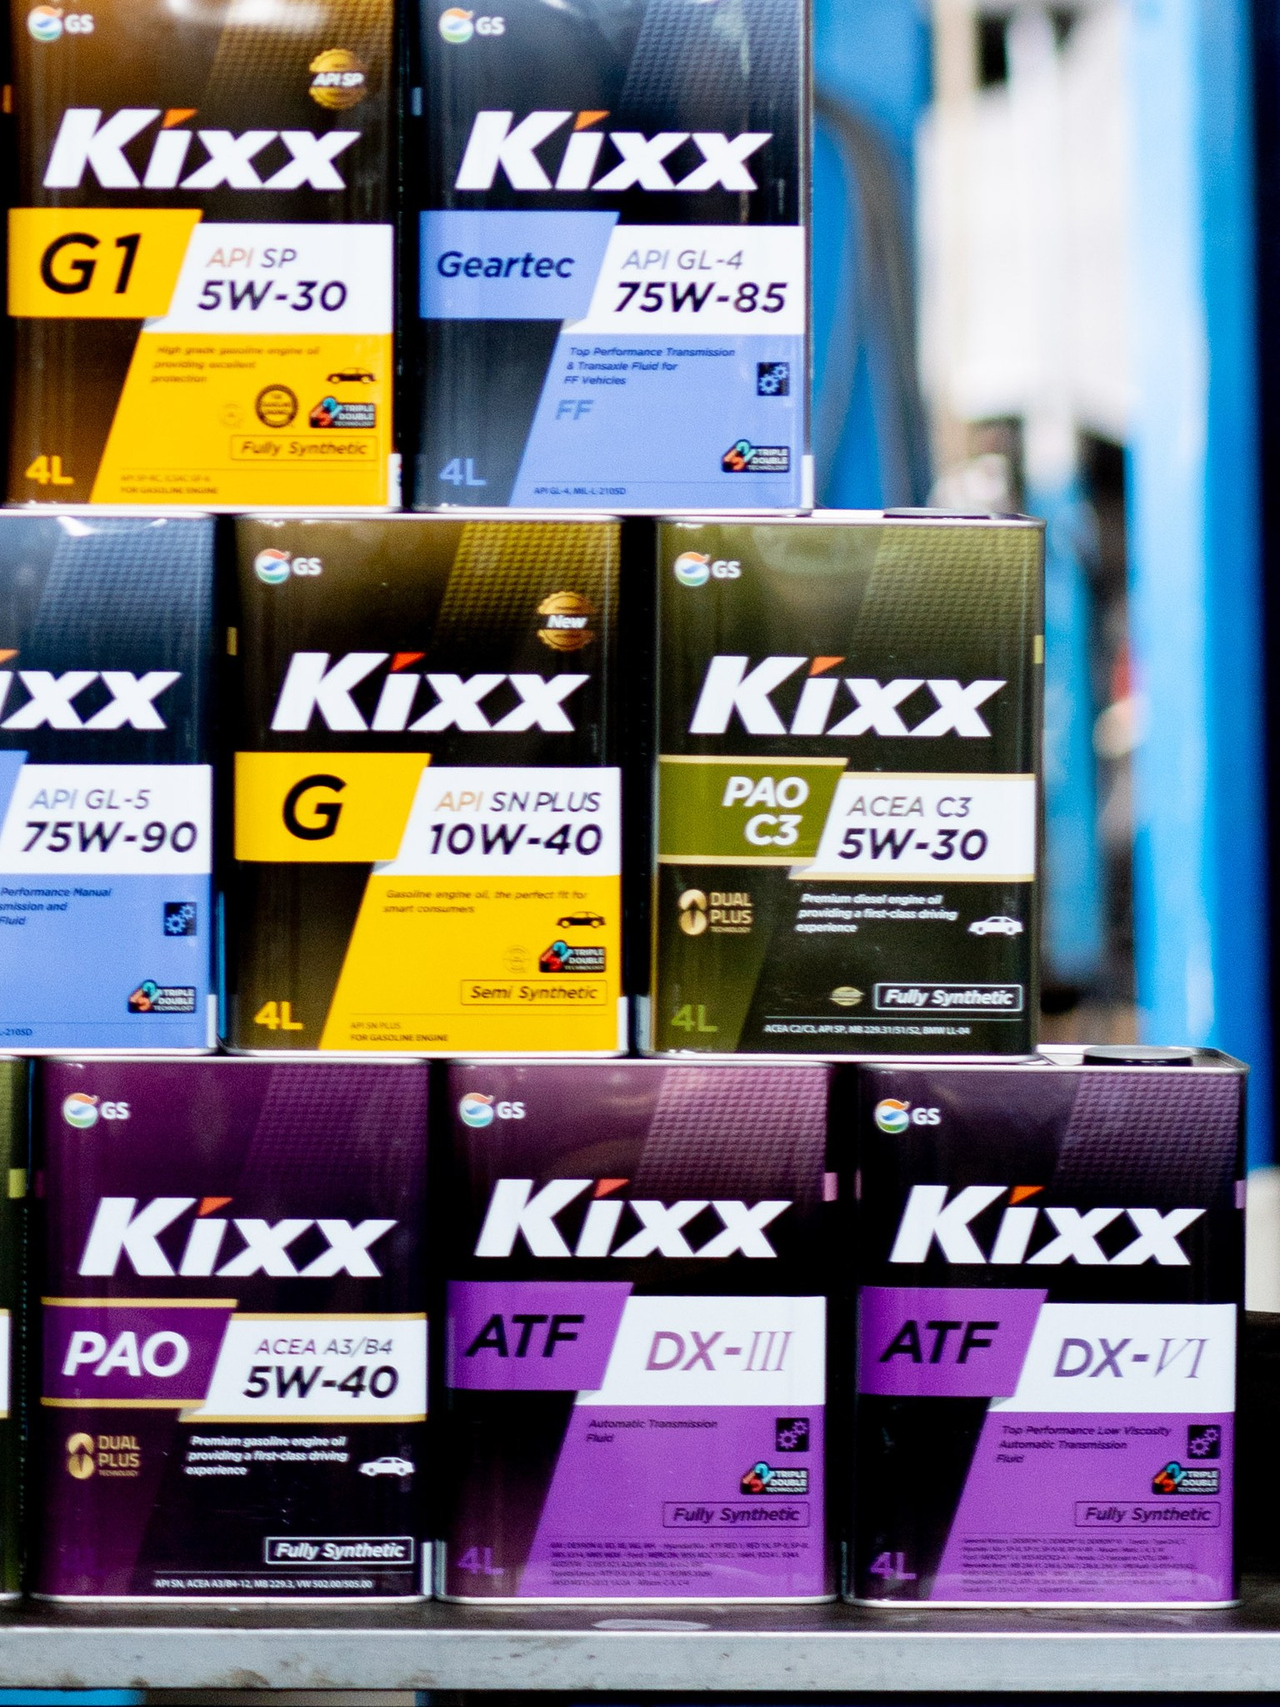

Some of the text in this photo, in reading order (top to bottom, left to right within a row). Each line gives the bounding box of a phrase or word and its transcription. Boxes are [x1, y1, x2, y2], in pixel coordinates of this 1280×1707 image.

[64, 14, 94, 34] GS
[475, 17, 505, 35] GS
[313, 73, 364, 86] API SP
[42, 108, 361, 190] Kixx
[454, 110, 773, 191] Kixx
[41, 233, 141, 295] G1
[206, 249, 297, 268] API SP
[437, 251, 575, 278] Geartec
[621, 249, 744, 270] API GL-4
[198, 281, 347, 312] 5W-30
[614, 282, 788, 313] 75W-85
[555, 400, 594, 420] FF
[242, 441, 368, 456] Fully Synthetic
[25, 455, 74, 485] 4L
[439, 458, 487, 486] 4L
[292, 557, 322, 575] GS
[712, 560, 741, 578] GS
[548, 615, 587, 627] New
[270, 652, 591, 732] Kixx
[689, 656, 1007, 737] Kixx
[29, 789, 151, 810] API GL-5
[434, 791, 601, 812] API SN PLUS
[722, 777, 809, 808] PAO
[282, 774, 347, 841] G
[847, 797, 973, 817] ACEA C3
[21, 821, 198, 853] 75W-90
[430, 823, 603, 855] 10W-40
[745, 814, 803, 846] C3
[838, 828, 988, 861] 5W-30
[0, 887, 71, 897] Performance
[73, 887, 111, 897] Manual
[710, 892, 752, 907] DUAL
[46, 902, 68, 910] and
[710, 910, 752, 924] PLUS
[158, 997, 195, 1005] DOUBLE
[471, 986, 599, 1000] Semi Synthetic
[885, 989, 928, 1006] Fully
[932, 989, 1014, 1006] Synthetic
[254, 1001, 303, 1031] 4L
[671, 1005, 718, 1032] 4L
[101, 1102, 130, 1119] GS
[497, 1102, 525, 1119] GS
[913, 1108, 940, 1125] GS
[474, 1179, 793, 1257] Kixx
[889, 1185, 1207, 1265] Kixx
[78, 1197, 399, 1277] Kixx
[465, 1314, 584, 1357] ATF
[879, 1321, 999, 1364] ATF
[63, 1331, 189, 1377] PAO
[255, 1339, 393, 1356] ACEA A3/B4
[1053, 1338, 1210, 1378] DX-VI
[244, 1366, 399, 1398] 5W-40
[589, 1420, 718, 1429] Automatic Transmission
[98, 1436, 141, 1449] DUAL
[586, 1434, 614, 1443] Fluid
[98, 1453, 139, 1467] PLUS
[1182, 1479, 1219, 1487] DOUBLE
[1188, 1471, 1219, 1479] TRIPLE
[673, 1508, 800, 1523] Fully Synthetic
[1085, 1508, 1211, 1522] Fully Synthetic
[275, 1544, 405, 1559] Fully Synthetic
[457, 1548, 504, 1576] 4L
[870, 1552, 917, 1580] 4L
